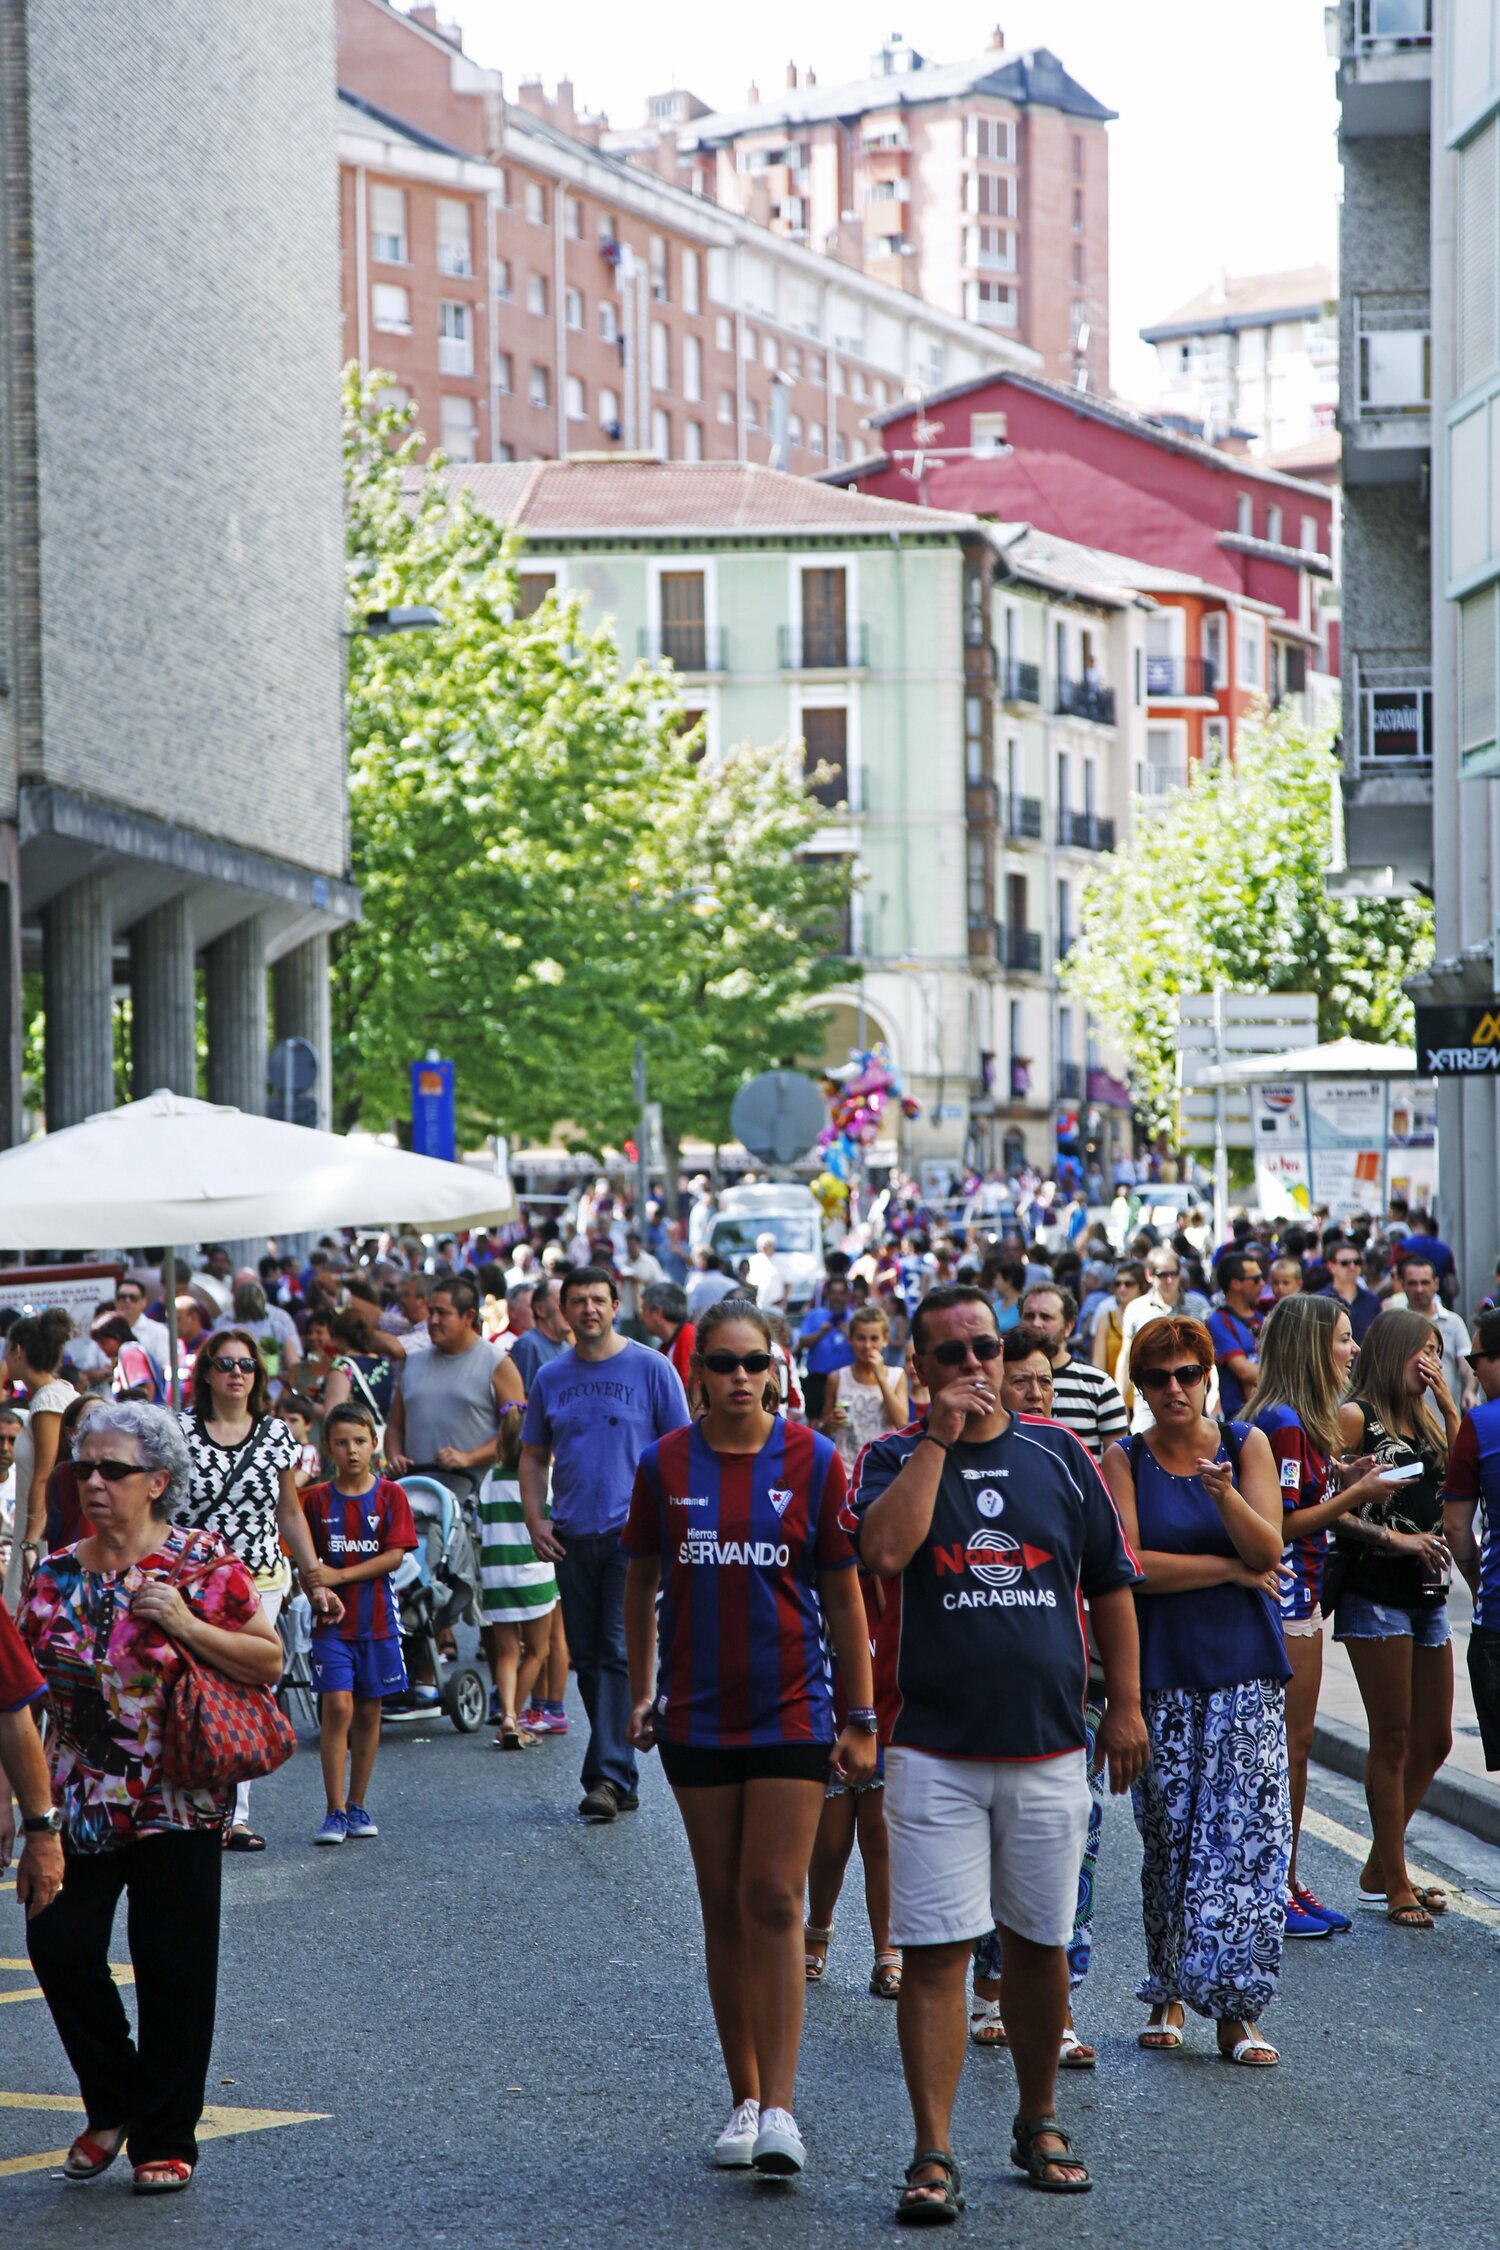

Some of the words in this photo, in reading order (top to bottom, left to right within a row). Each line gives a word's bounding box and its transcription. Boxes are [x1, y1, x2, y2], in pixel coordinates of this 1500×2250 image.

[669, 1494, 709, 1507] hummel
[687, 1528, 718, 1540] Hierros
[328, 1540, 379, 1553] SERVANDO
[678, 1541, 790, 1568] SERVANDO
[934, 1543, 1024, 1576] NORICA
[943, 1589, 1057, 1610] CARABINAS
